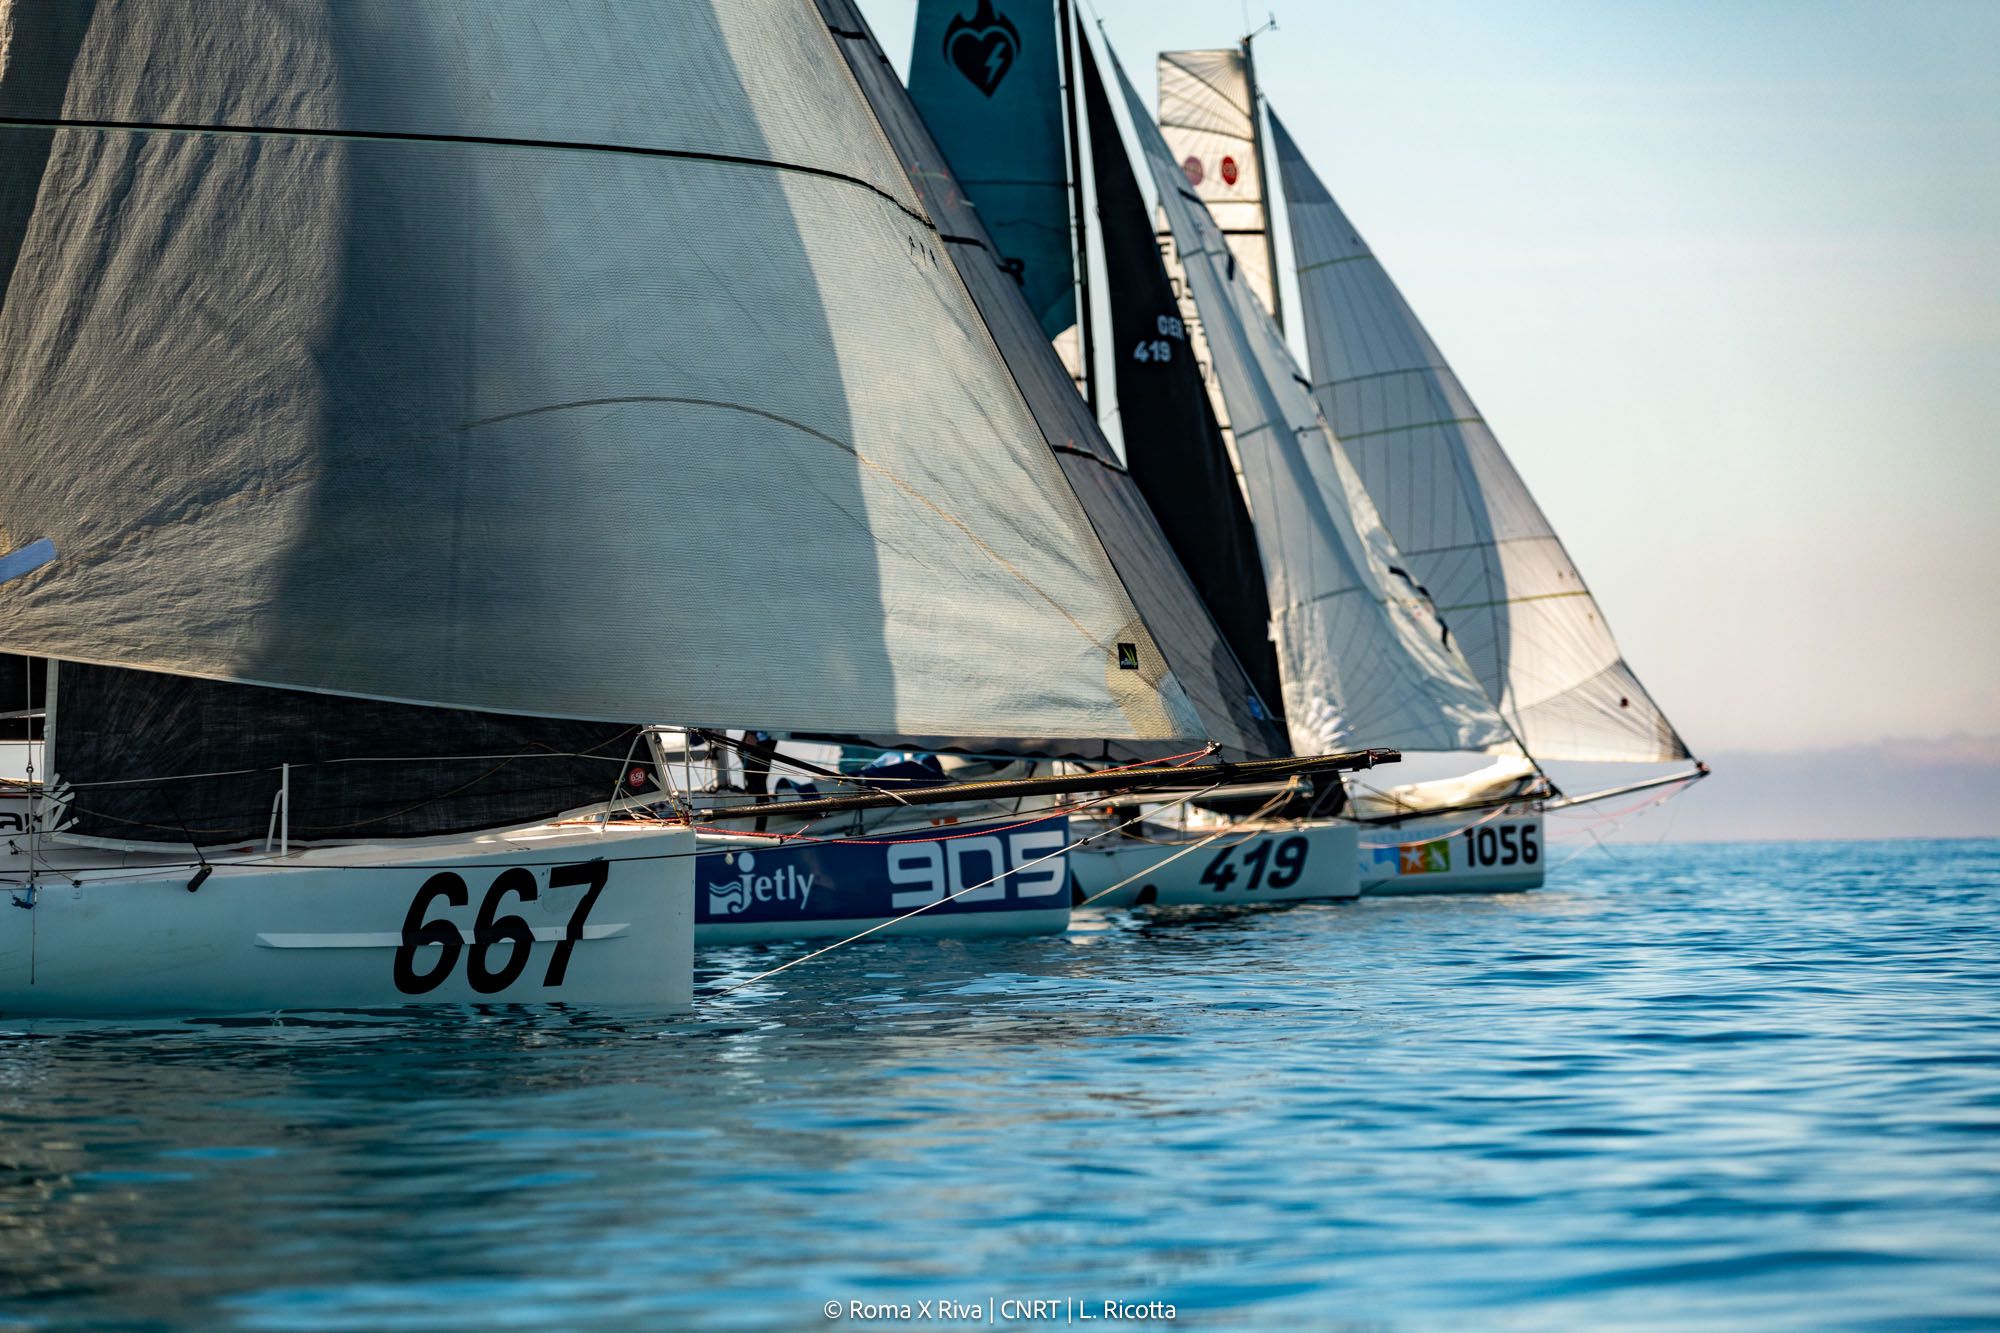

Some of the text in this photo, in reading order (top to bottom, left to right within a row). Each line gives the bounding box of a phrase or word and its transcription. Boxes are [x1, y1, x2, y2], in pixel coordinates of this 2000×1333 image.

[1134, 341, 1171, 362] 419
[887, 831, 1066, 909] 905
[1199, 836, 1310, 893] 419
[1463, 824, 1539, 868] 1056
[393, 860, 610, 995] 667
